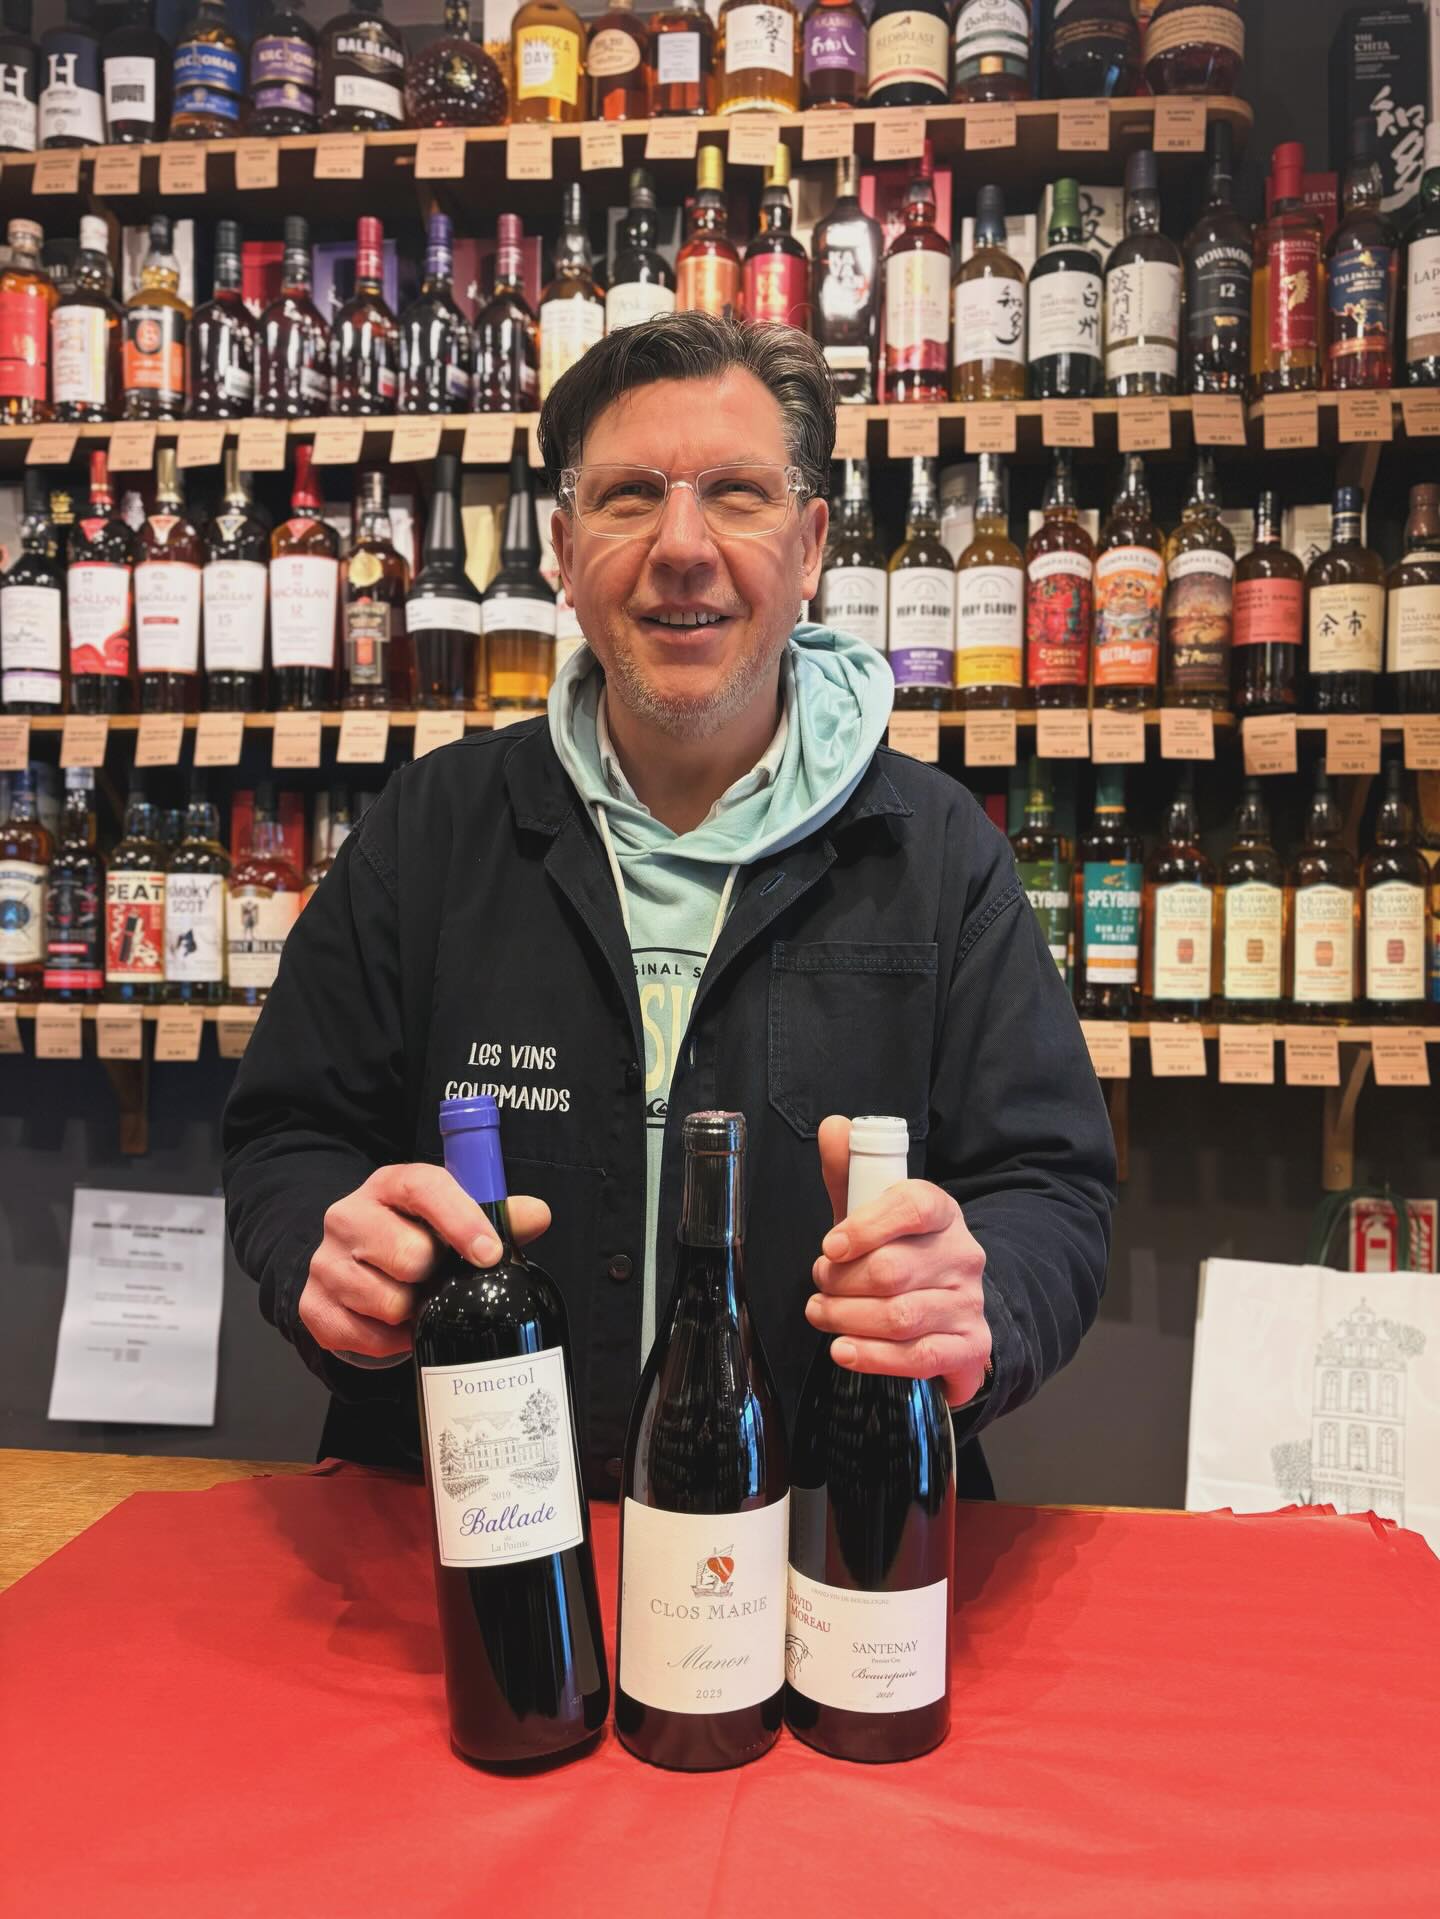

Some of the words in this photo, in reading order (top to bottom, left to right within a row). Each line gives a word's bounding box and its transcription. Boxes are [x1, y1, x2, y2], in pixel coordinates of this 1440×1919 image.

[523, 36, 572, 52] NIKKA
[523, 51, 560, 65] DAYS
[896, 53, 911, 66] 12
[1219, 283, 1236, 298] 12
[1333, 270, 1385, 287] TALISKER
[1316, 610, 1367, 638] 余市
[107, 883, 163, 901] PEAT
[510, 1044, 557, 1070] VINS
[445, 1079, 571, 1112] GOURMANDS
[453, 1367, 535, 1396] Pomerol
[460, 1503, 557, 1537] Ballade
[491, 1543, 502, 1552] La
[650, 1598, 700, 1620] CLOS
[707, 1596, 768, 1620] MARIE
[788, 1587, 813, 1612] DAVID
[790, 1604, 832, 1633] MOREAU
[666, 1643, 751, 1671] Manon
[852, 1639, 919, 1655] SANTENAY
